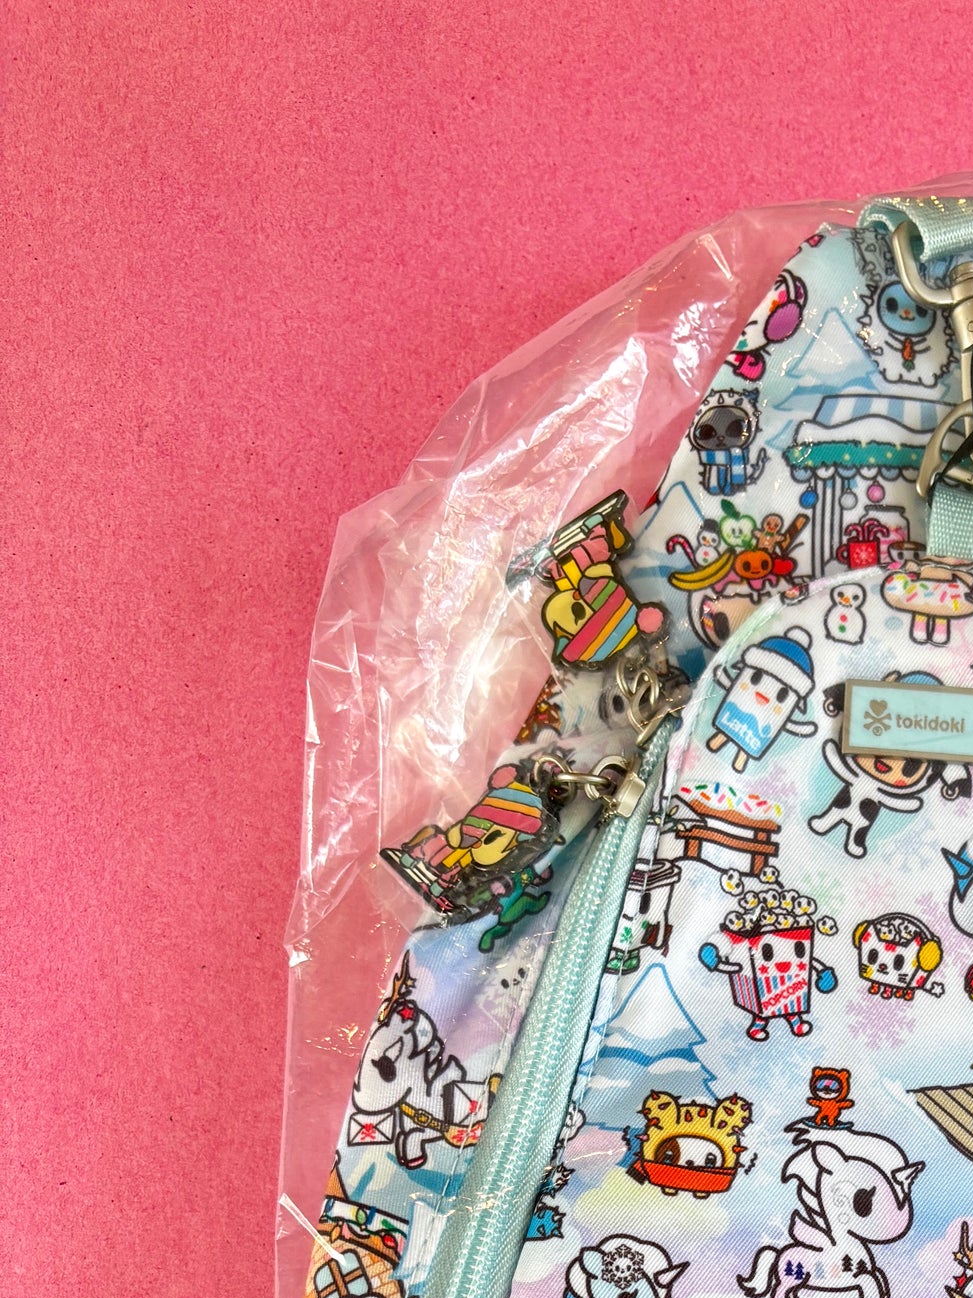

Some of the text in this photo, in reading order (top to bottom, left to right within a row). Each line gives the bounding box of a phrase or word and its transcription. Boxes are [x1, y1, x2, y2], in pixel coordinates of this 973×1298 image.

[720, 711, 762, 751] Latte
[895, 714, 966, 734] tokidoki
[761, 977, 808, 1011] POPCORN
